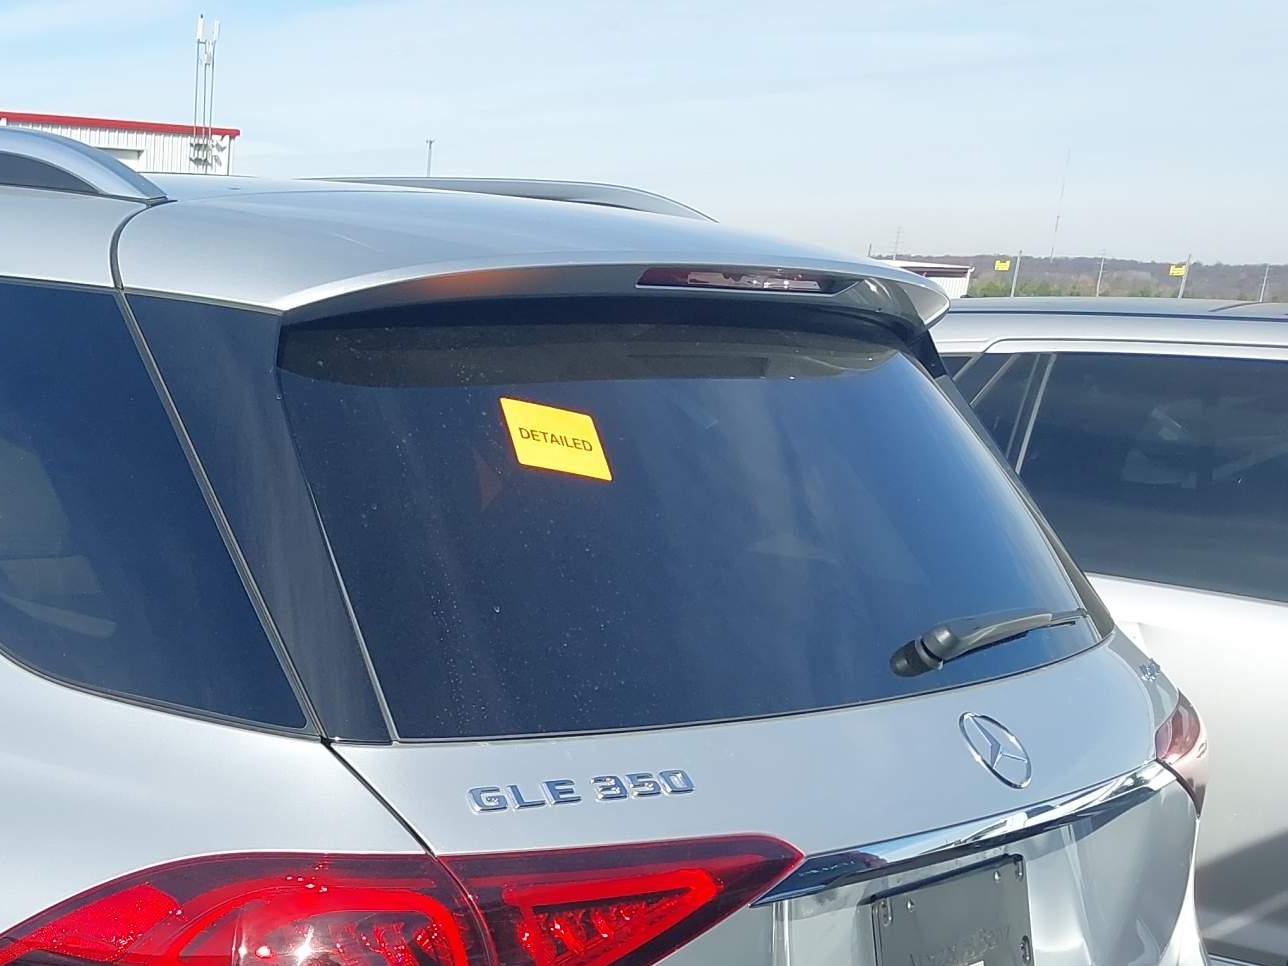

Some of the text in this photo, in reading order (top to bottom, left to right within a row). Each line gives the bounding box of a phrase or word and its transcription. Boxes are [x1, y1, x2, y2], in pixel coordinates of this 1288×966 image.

[518, 427, 593, 452] DETAILED
[468, 769, 696, 814] GLE 350
